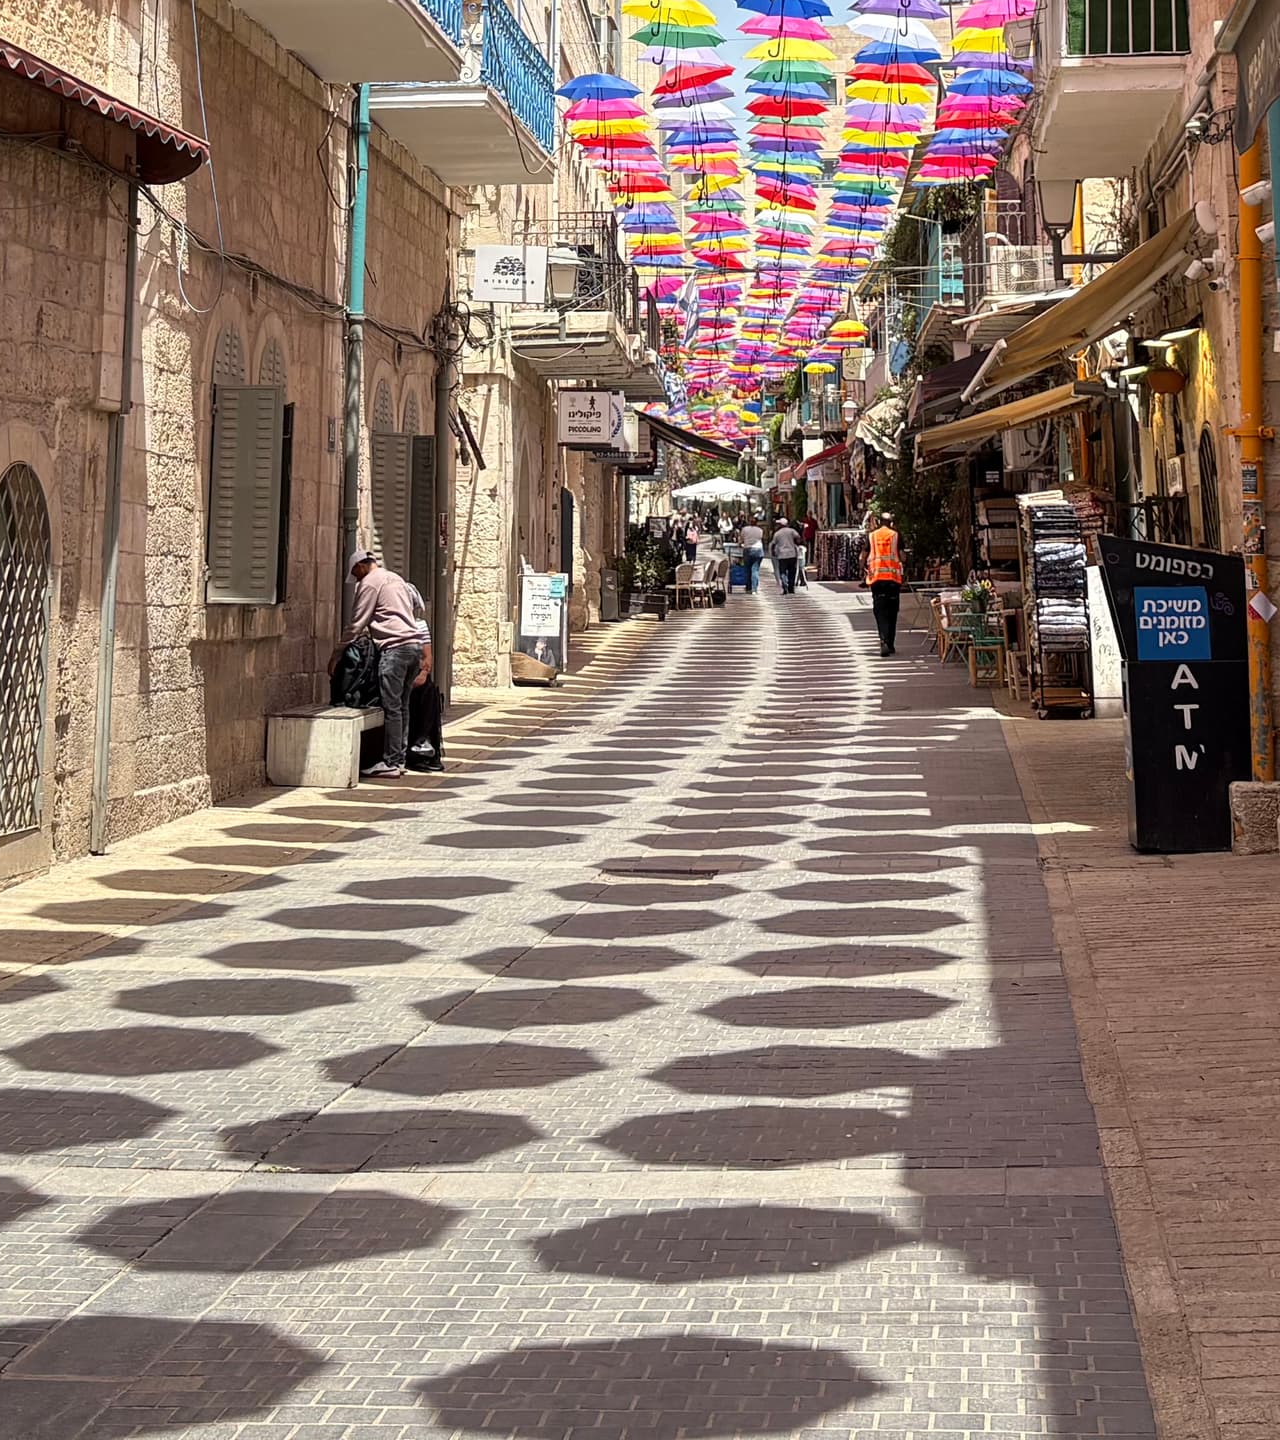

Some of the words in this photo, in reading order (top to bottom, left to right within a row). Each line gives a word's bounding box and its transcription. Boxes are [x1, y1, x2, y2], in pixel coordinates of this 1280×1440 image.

[568, 410, 602, 419] פיקולינו
[1135, 552, 1214, 580] כספומט
[1142, 600, 1202, 614] משיכת
[1139, 615, 1206, 629] מזומנים
[1158, 631, 1189, 648] כאן
